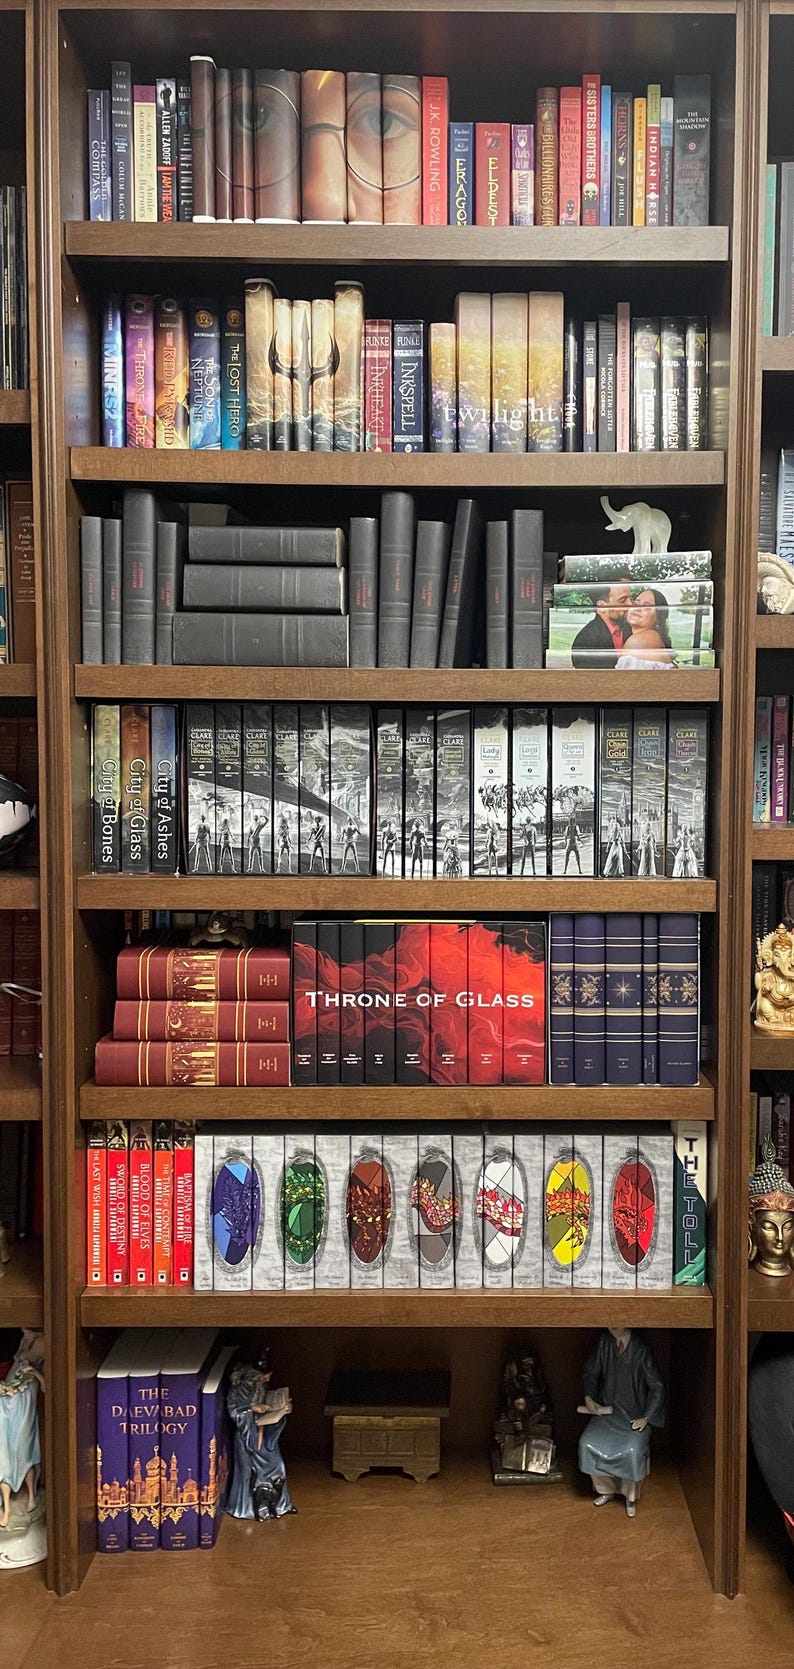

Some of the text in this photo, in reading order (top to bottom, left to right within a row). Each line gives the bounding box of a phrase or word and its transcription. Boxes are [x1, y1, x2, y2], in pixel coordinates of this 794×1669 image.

[162, 110, 171, 166] ALLEN ZADOFF
[430, 104, 440, 192] J.K. ROWLING
[563, 134, 576, 143] Old
[586, 90, 596, 180] SISTERS BROTHERS
[618, 106, 627, 149] HORNS
[92, 140, 101, 200] COMPASS
[180, 148, 192, 205] INFINITE
[542, 134, 554, 204] BILLIONAIRE'S
[636, 150, 644, 209] FLUSH
[649, 131, 658, 177] INDIAN
[138, 179, 147, 218] Barrows
[147, 186, 155, 212] Annie
[162, 176, 172, 188] AM
[162, 188, 172, 204] THE
[488, 158, 499, 226] ELDEST
[163, 348, 176, 380] RED
[366, 336, 390, 347] FUNKE
[397, 336, 420, 346] FUNKE
[586, 347, 594, 365] STONE
[104, 344, 118, 420] MINRS2
[136, 351, 146, 402] THRONE
[191, 358, 205, 423] NEPTUNE
[204, 358, 218, 422] THE SON OF
[226, 344, 242, 438] THE LOST HERO
[368, 362, 387, 432] INKHEART
[399, 362, 419, 432] INKSPELL
[136, 414, 146, 444] FIRE
[163, 382, 176, 446] PYRAMID
[444, 398, 560, 430] twilight
[642, 388, 656, 449] FABLEHAVEN
[666, 388, 680, 448] FABLEHAVEN
[687, 388, 701, 448] FABLEHAVEN
[782, 490, 794, 528] SALVATORE
[104, 718, 112, 744] CLARE
[480, 736, 502, 744] CLARE
[482, 746, 500, 756] Lady
[639, 738, 658, 746] Chain
[776, 744, 784, 805] THE BLACK UNICORN
[98, 759, 118, 863] City of Bones
[126, 758, 146, 860] City of Glass
[154, 759, 173, 860] City of Ashes
[305, 990, 535, 1008] THRONE OF GLASS
[92, 1162, 100, 1182] LAST
[92, 1184, 100, 1207] WISH
[92, 1209, 100, 1233] ANDRZEJ
[109, 1178, 117, 1243] ANDRZEJ SAPKOWSKI
[116, 1163, 125, 1256] SWORD OF DESTINY
[140, 1163, 150, 1250] BLOOD OF ELVES
[163, 1198, 170, 1207] OF
[184, 1173, 192, 1244] BAPTISM OF FIRE
[682, 1137, 699, 1265] THE TOLL
[92, 1235, 100, 1265] SAPKOWSKI
[112, 1404, 198, 1418] DAEVABAD
[138, 1388, 170, 1400] THE
[120, 1421, 188, 1435] TRILOGY
